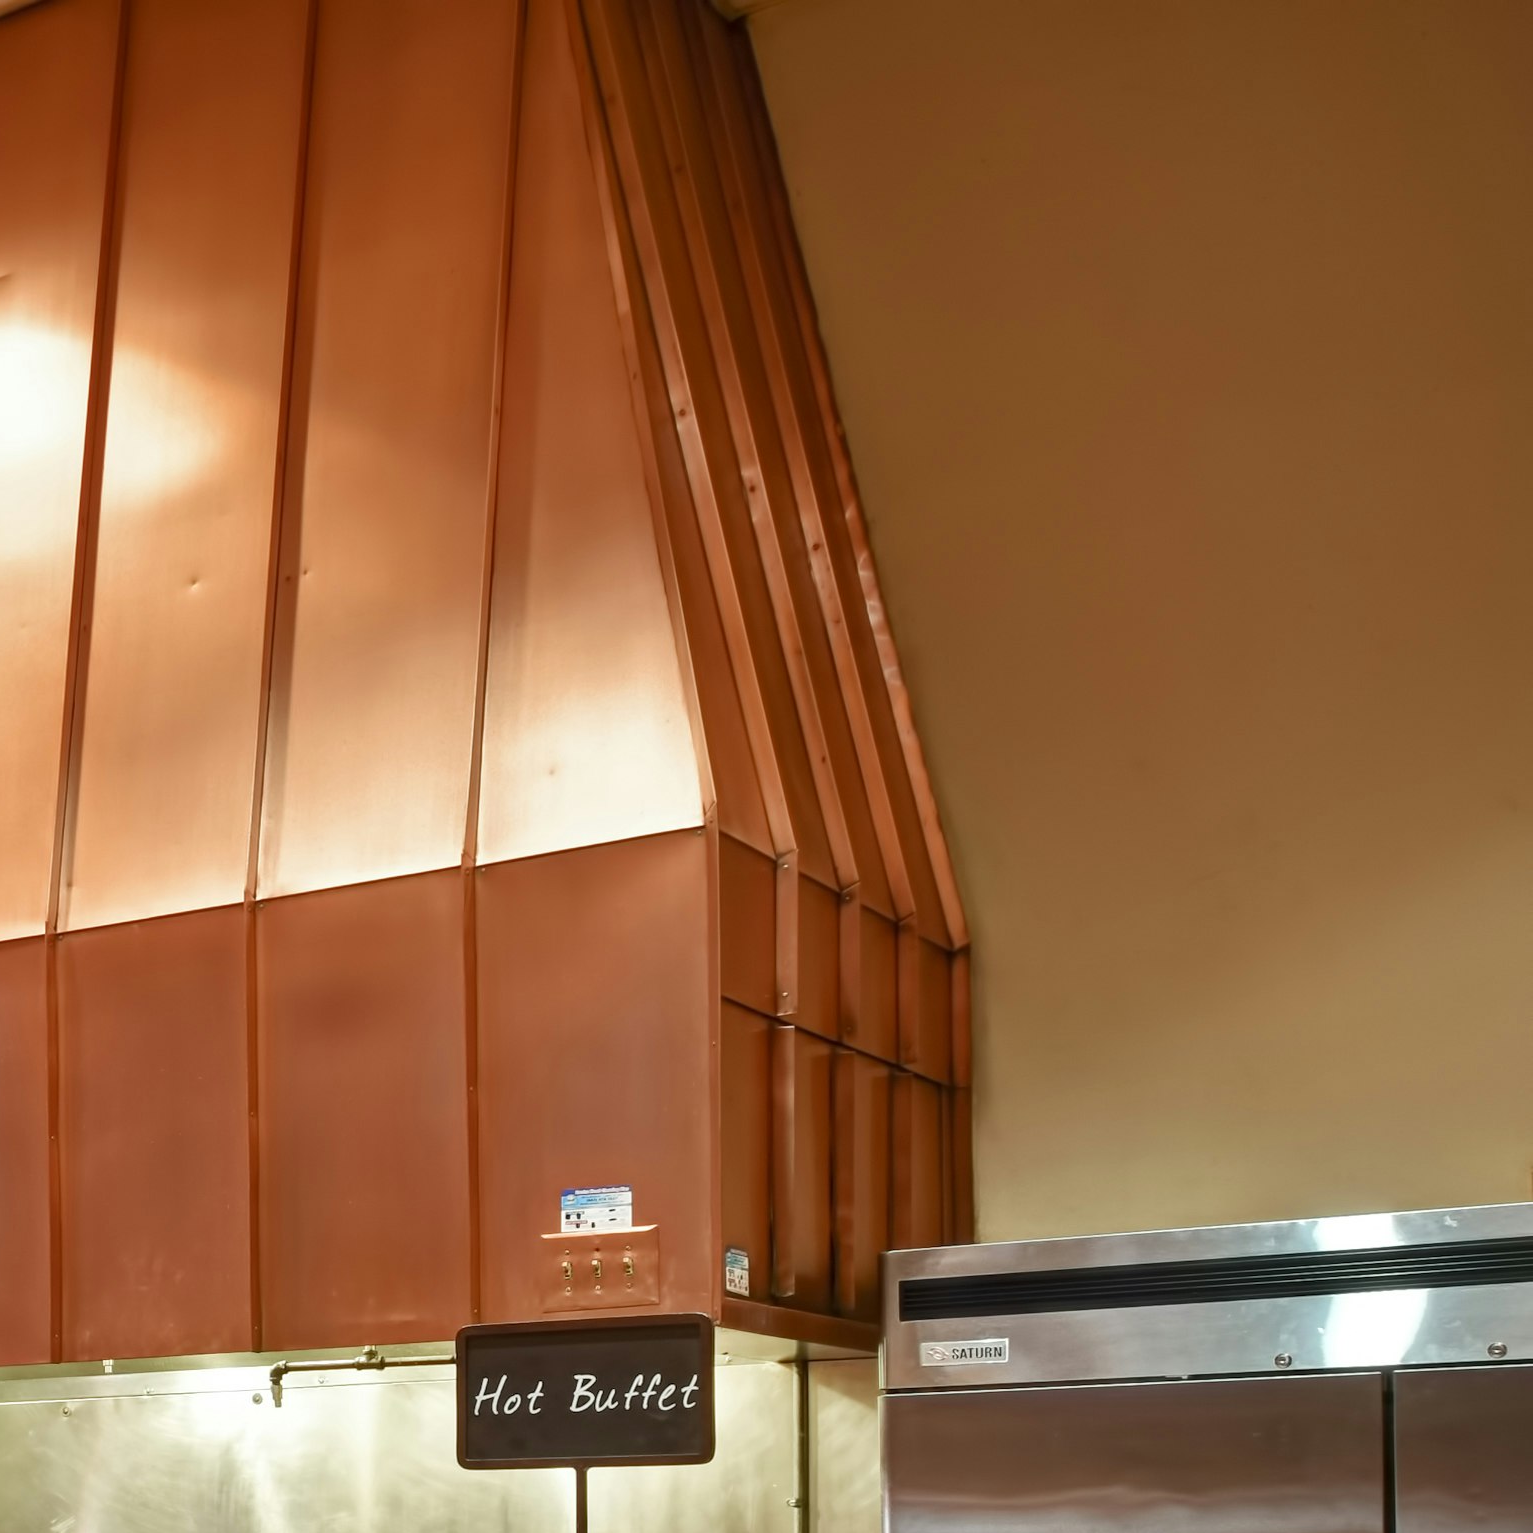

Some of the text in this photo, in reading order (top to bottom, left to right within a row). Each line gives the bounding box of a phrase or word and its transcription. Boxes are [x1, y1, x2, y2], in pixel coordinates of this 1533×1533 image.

[952, 1346, 1003, 1359] SATURN
[473, 1373, 699, 1416] Hot Buffet
